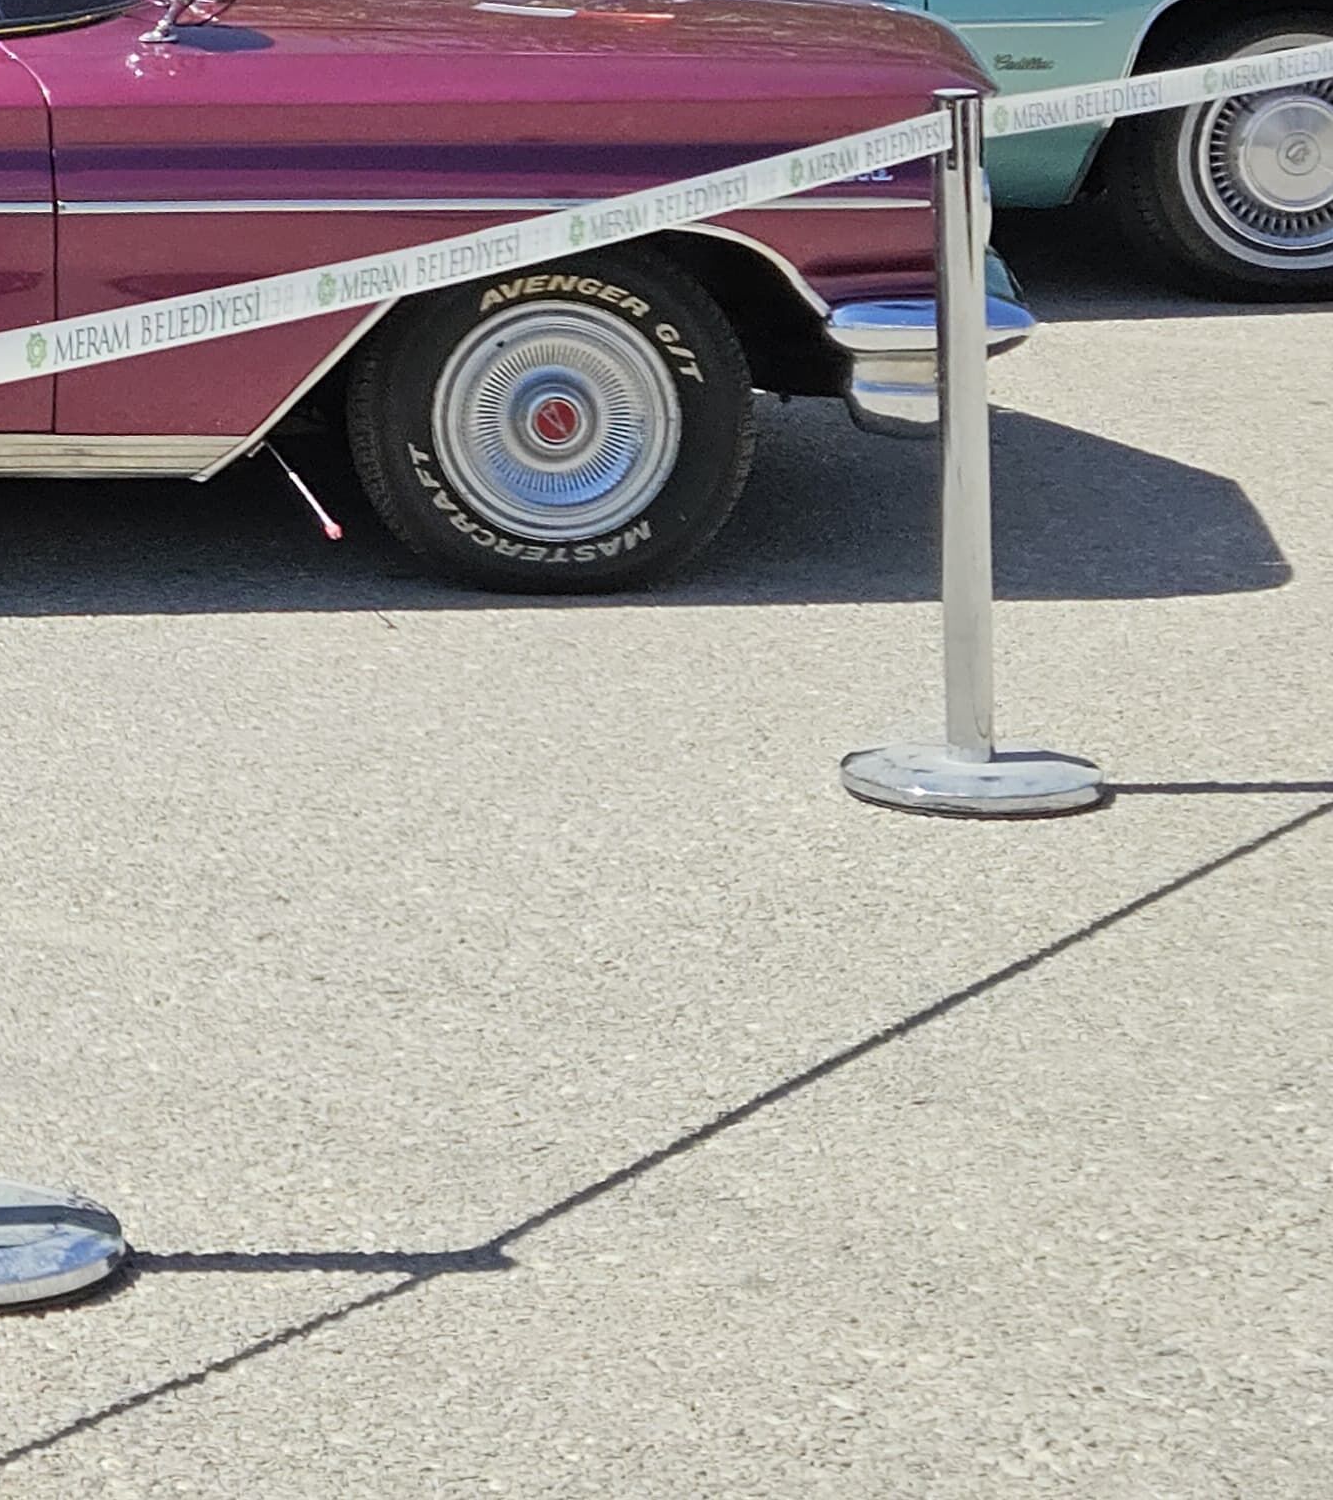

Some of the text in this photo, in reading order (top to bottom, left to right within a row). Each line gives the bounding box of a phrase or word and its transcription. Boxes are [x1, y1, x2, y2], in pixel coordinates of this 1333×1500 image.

[1013, 102, 1069, 131] MERAM
[808, 147, 860, 183] MERAM
[589, 206, 648, 242] MERAM
[340, 262, 409, 303] MERAM
[478, 274, 651, 318] AVENGER
[53, 320, 131, 365] MERAM
[141, 286, 262, 346] BELEDİYESİ
[407, 441, 654, 564] MASTERCRAFT
